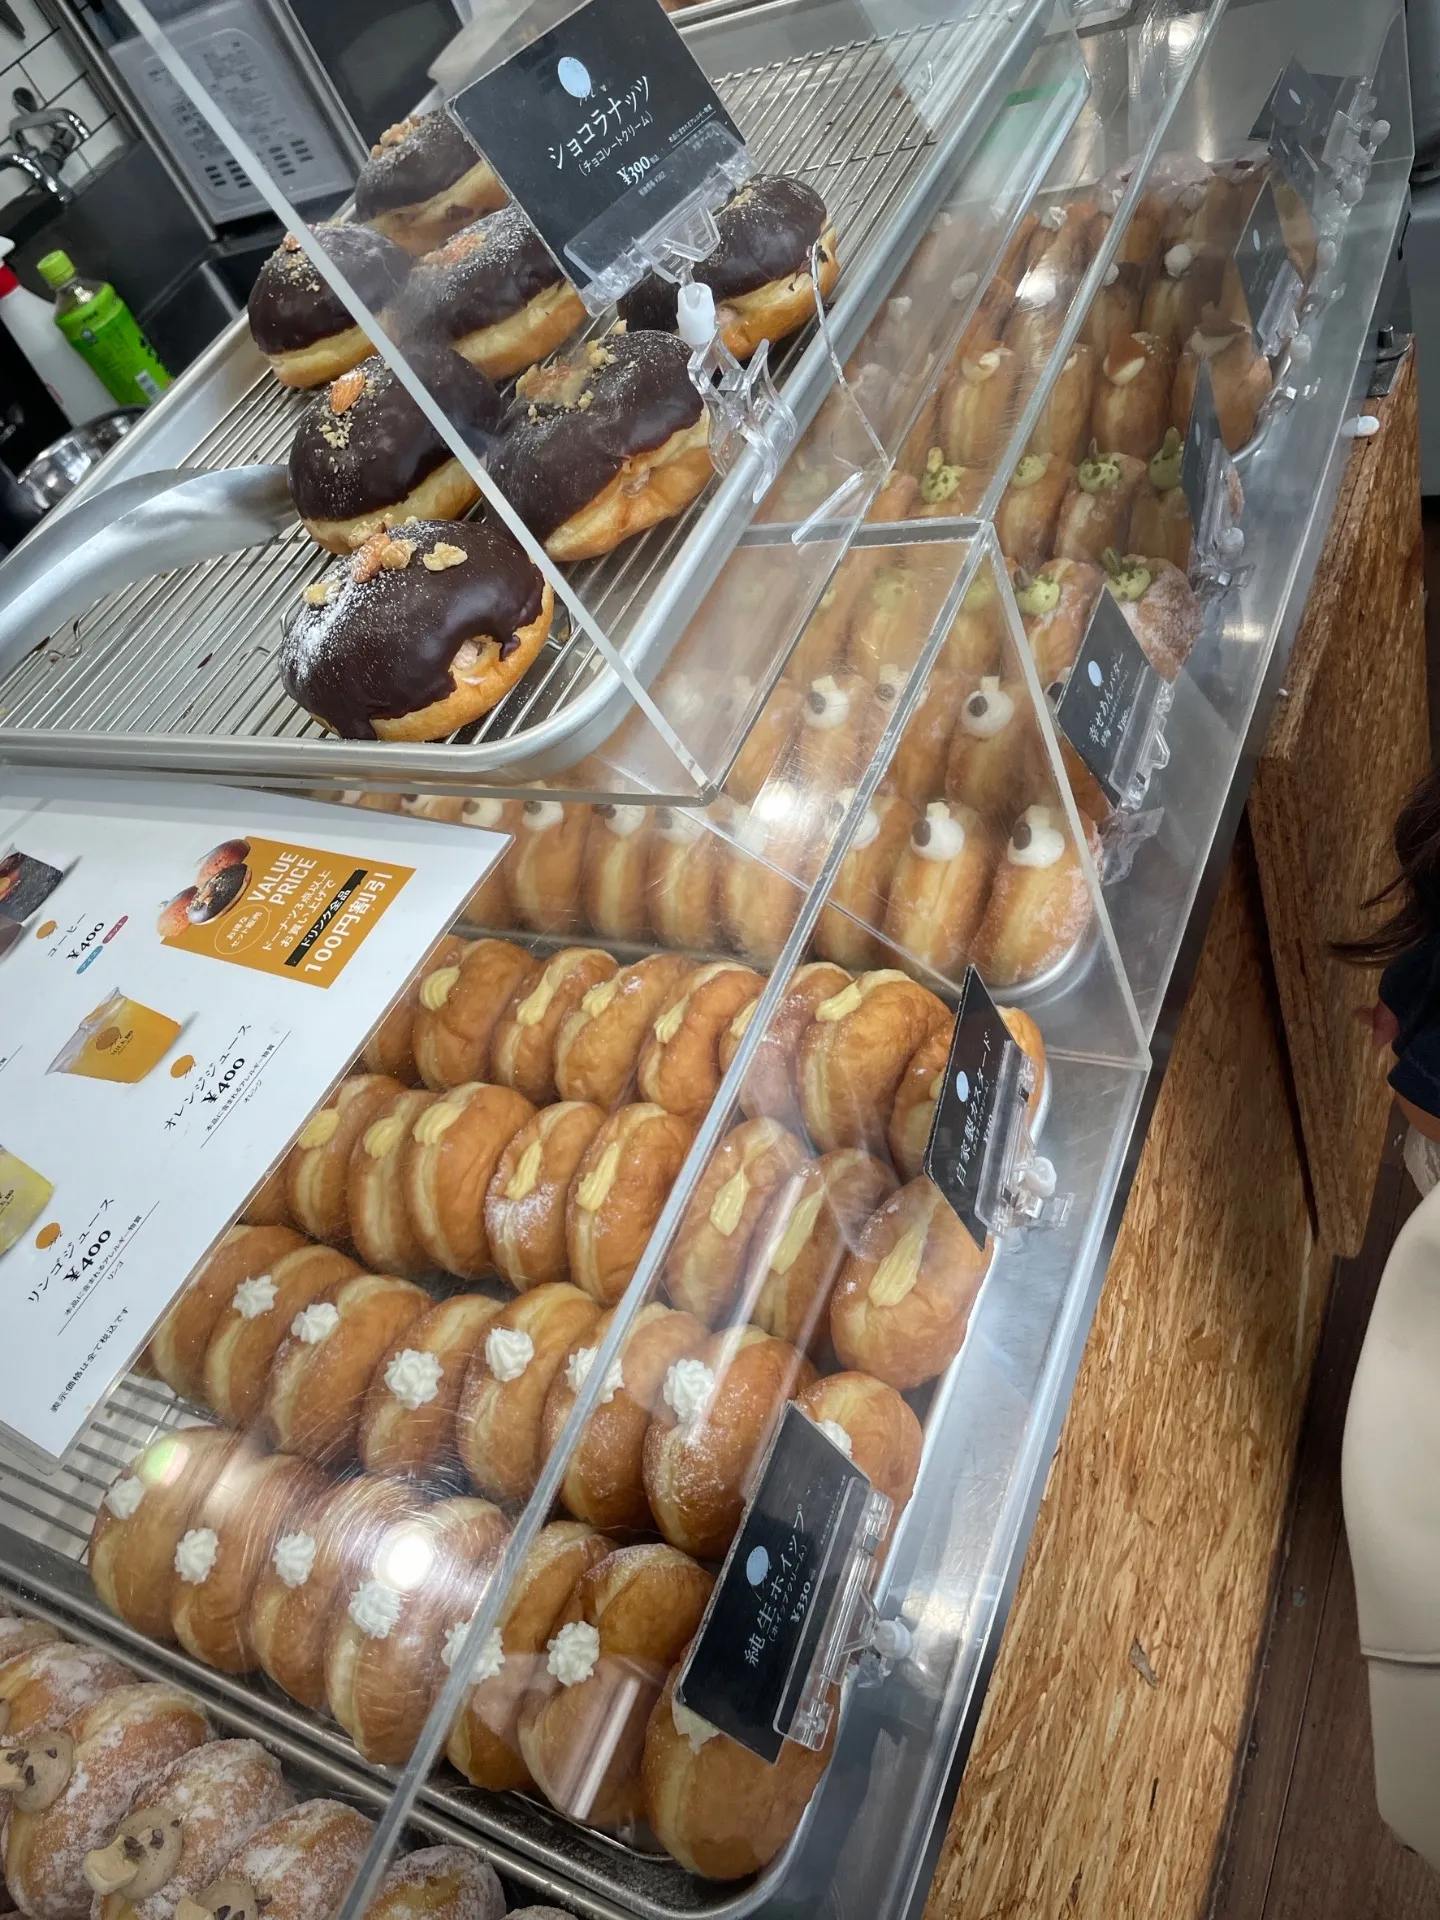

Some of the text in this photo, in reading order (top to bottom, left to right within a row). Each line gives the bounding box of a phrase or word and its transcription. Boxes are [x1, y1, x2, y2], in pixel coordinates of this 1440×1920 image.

[548, 75, 650, 170] ショコラナッツ
[616, 156, 651, 186] ¥390
[247, 852, 300, 901] VALUE
[268, 858, 319, 905] PRICE
[48, 913, 87, 958] コーヒー
[66, 922, 105, 960] ¥400
[280, 879, 336, 948] お買い上げで
[300, 889, 352, 947] ドリンク全品
[304, 872, 393, 972] 100円割引
[164, 1024, 252, 1131] オレンジジュース
[200, 1058, 245, 1103] ¥400
[28, 1199, 115, 1303] リンゴジュース
[62, 1230, 111, 1282] ¥400
[50, 1306, 129, 1414] 表示価格は全て税込です
[744, 1503, 804, 1668] 純生ホイップ
[790, 1581, 811, 1623] ¥330
